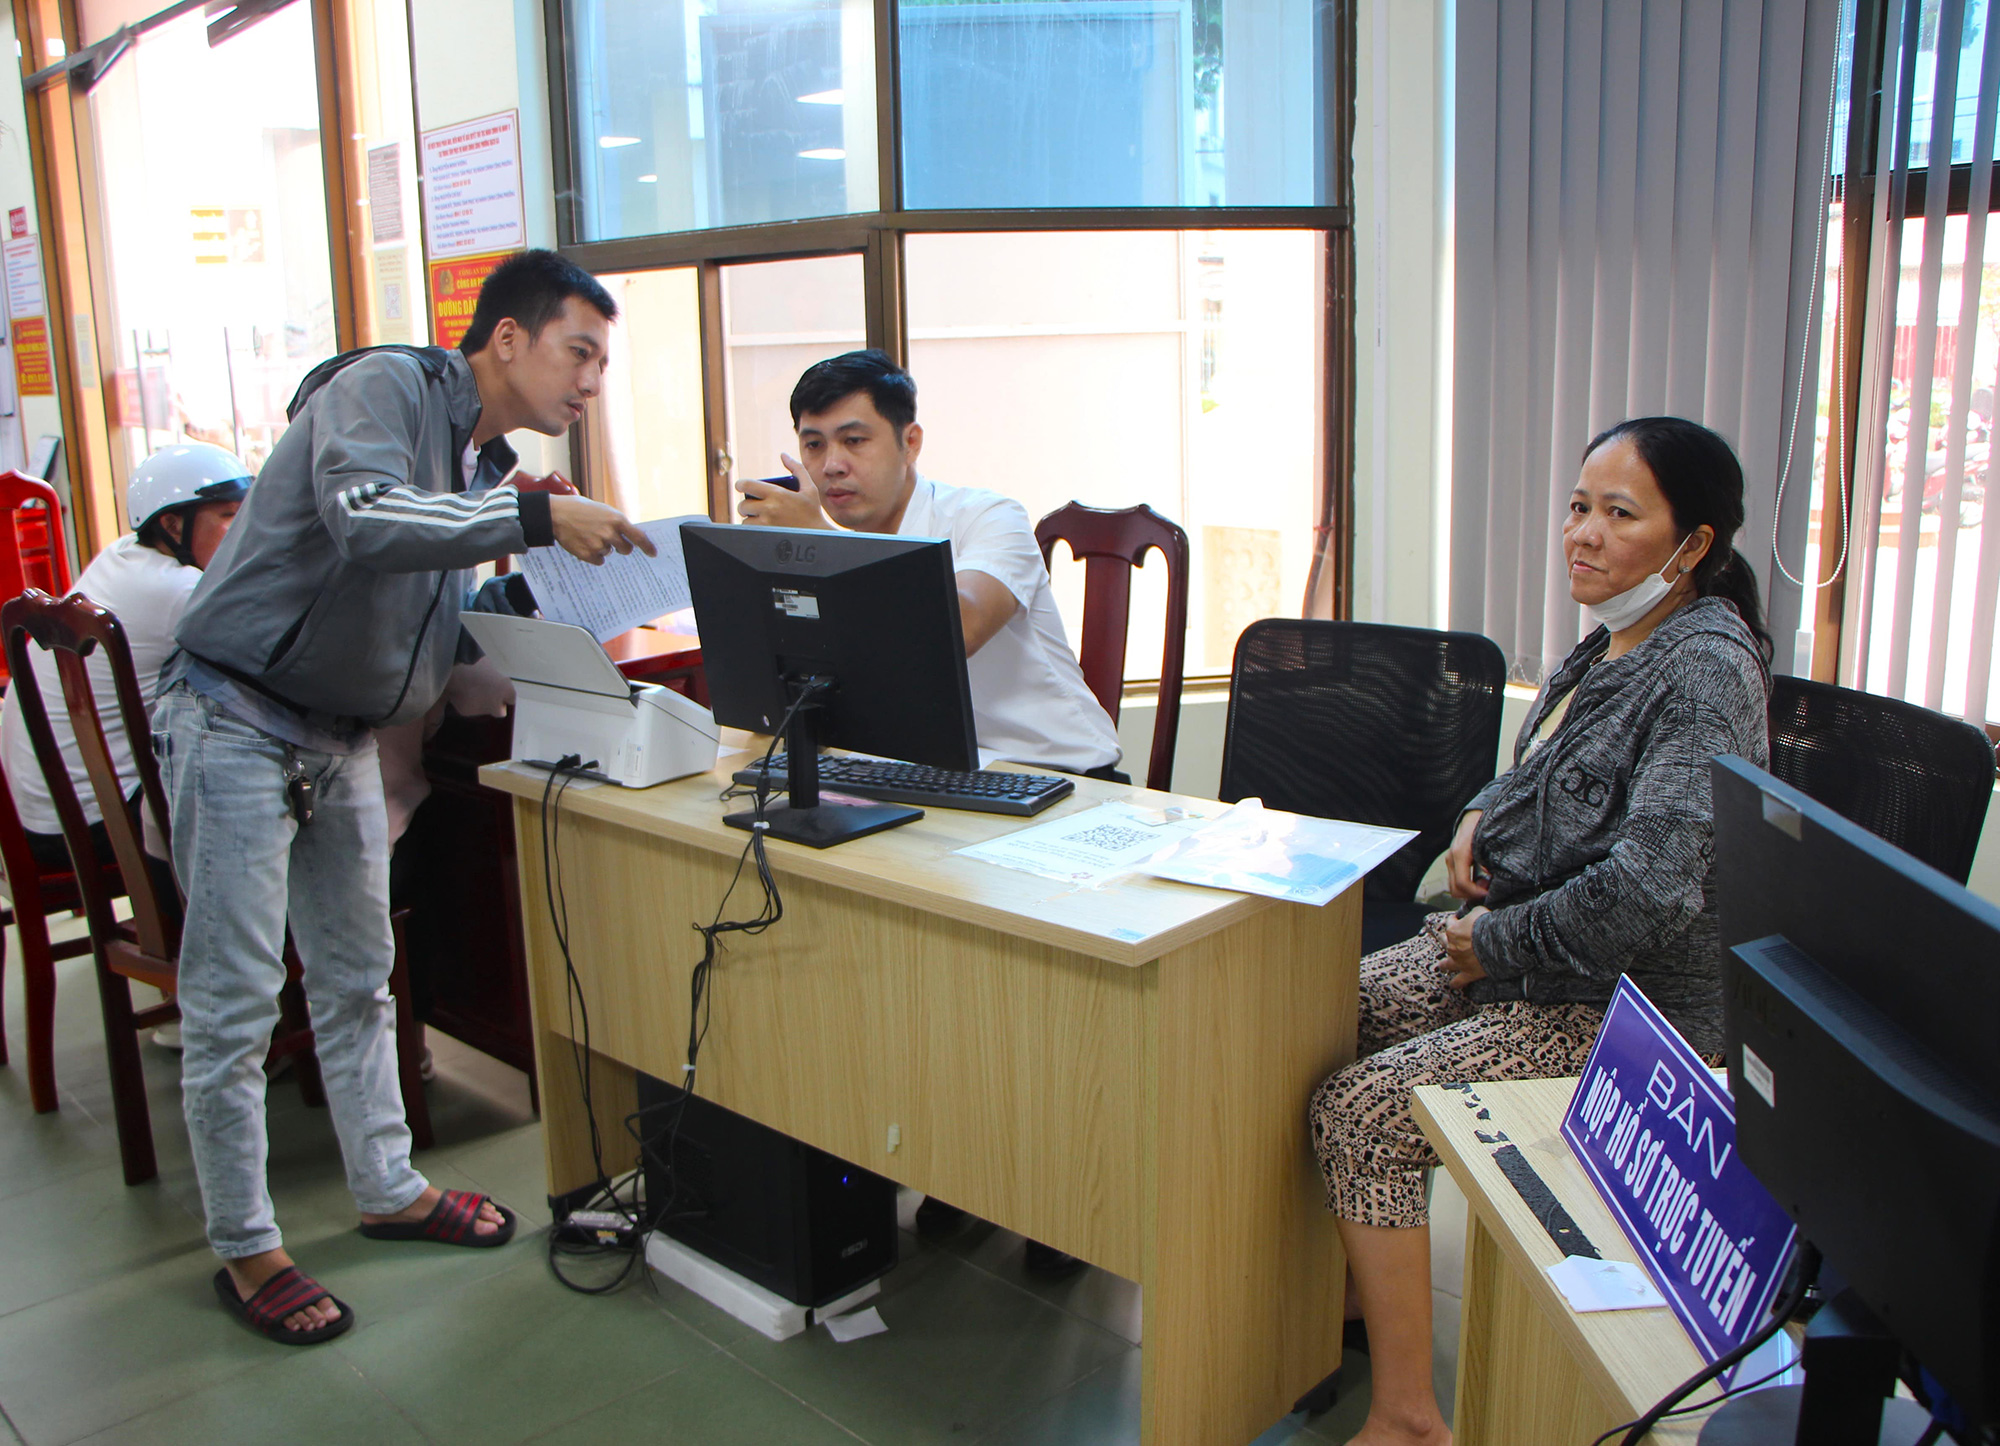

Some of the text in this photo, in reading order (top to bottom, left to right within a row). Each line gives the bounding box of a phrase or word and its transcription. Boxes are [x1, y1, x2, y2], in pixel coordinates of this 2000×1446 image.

[795, 545, 817, 563] LG
[1646, 1059, 1732, 1180] BÀN
[1580, 1065, 1757, 1336] NỘP HỒ SƠ TRỰC TUYẾN
